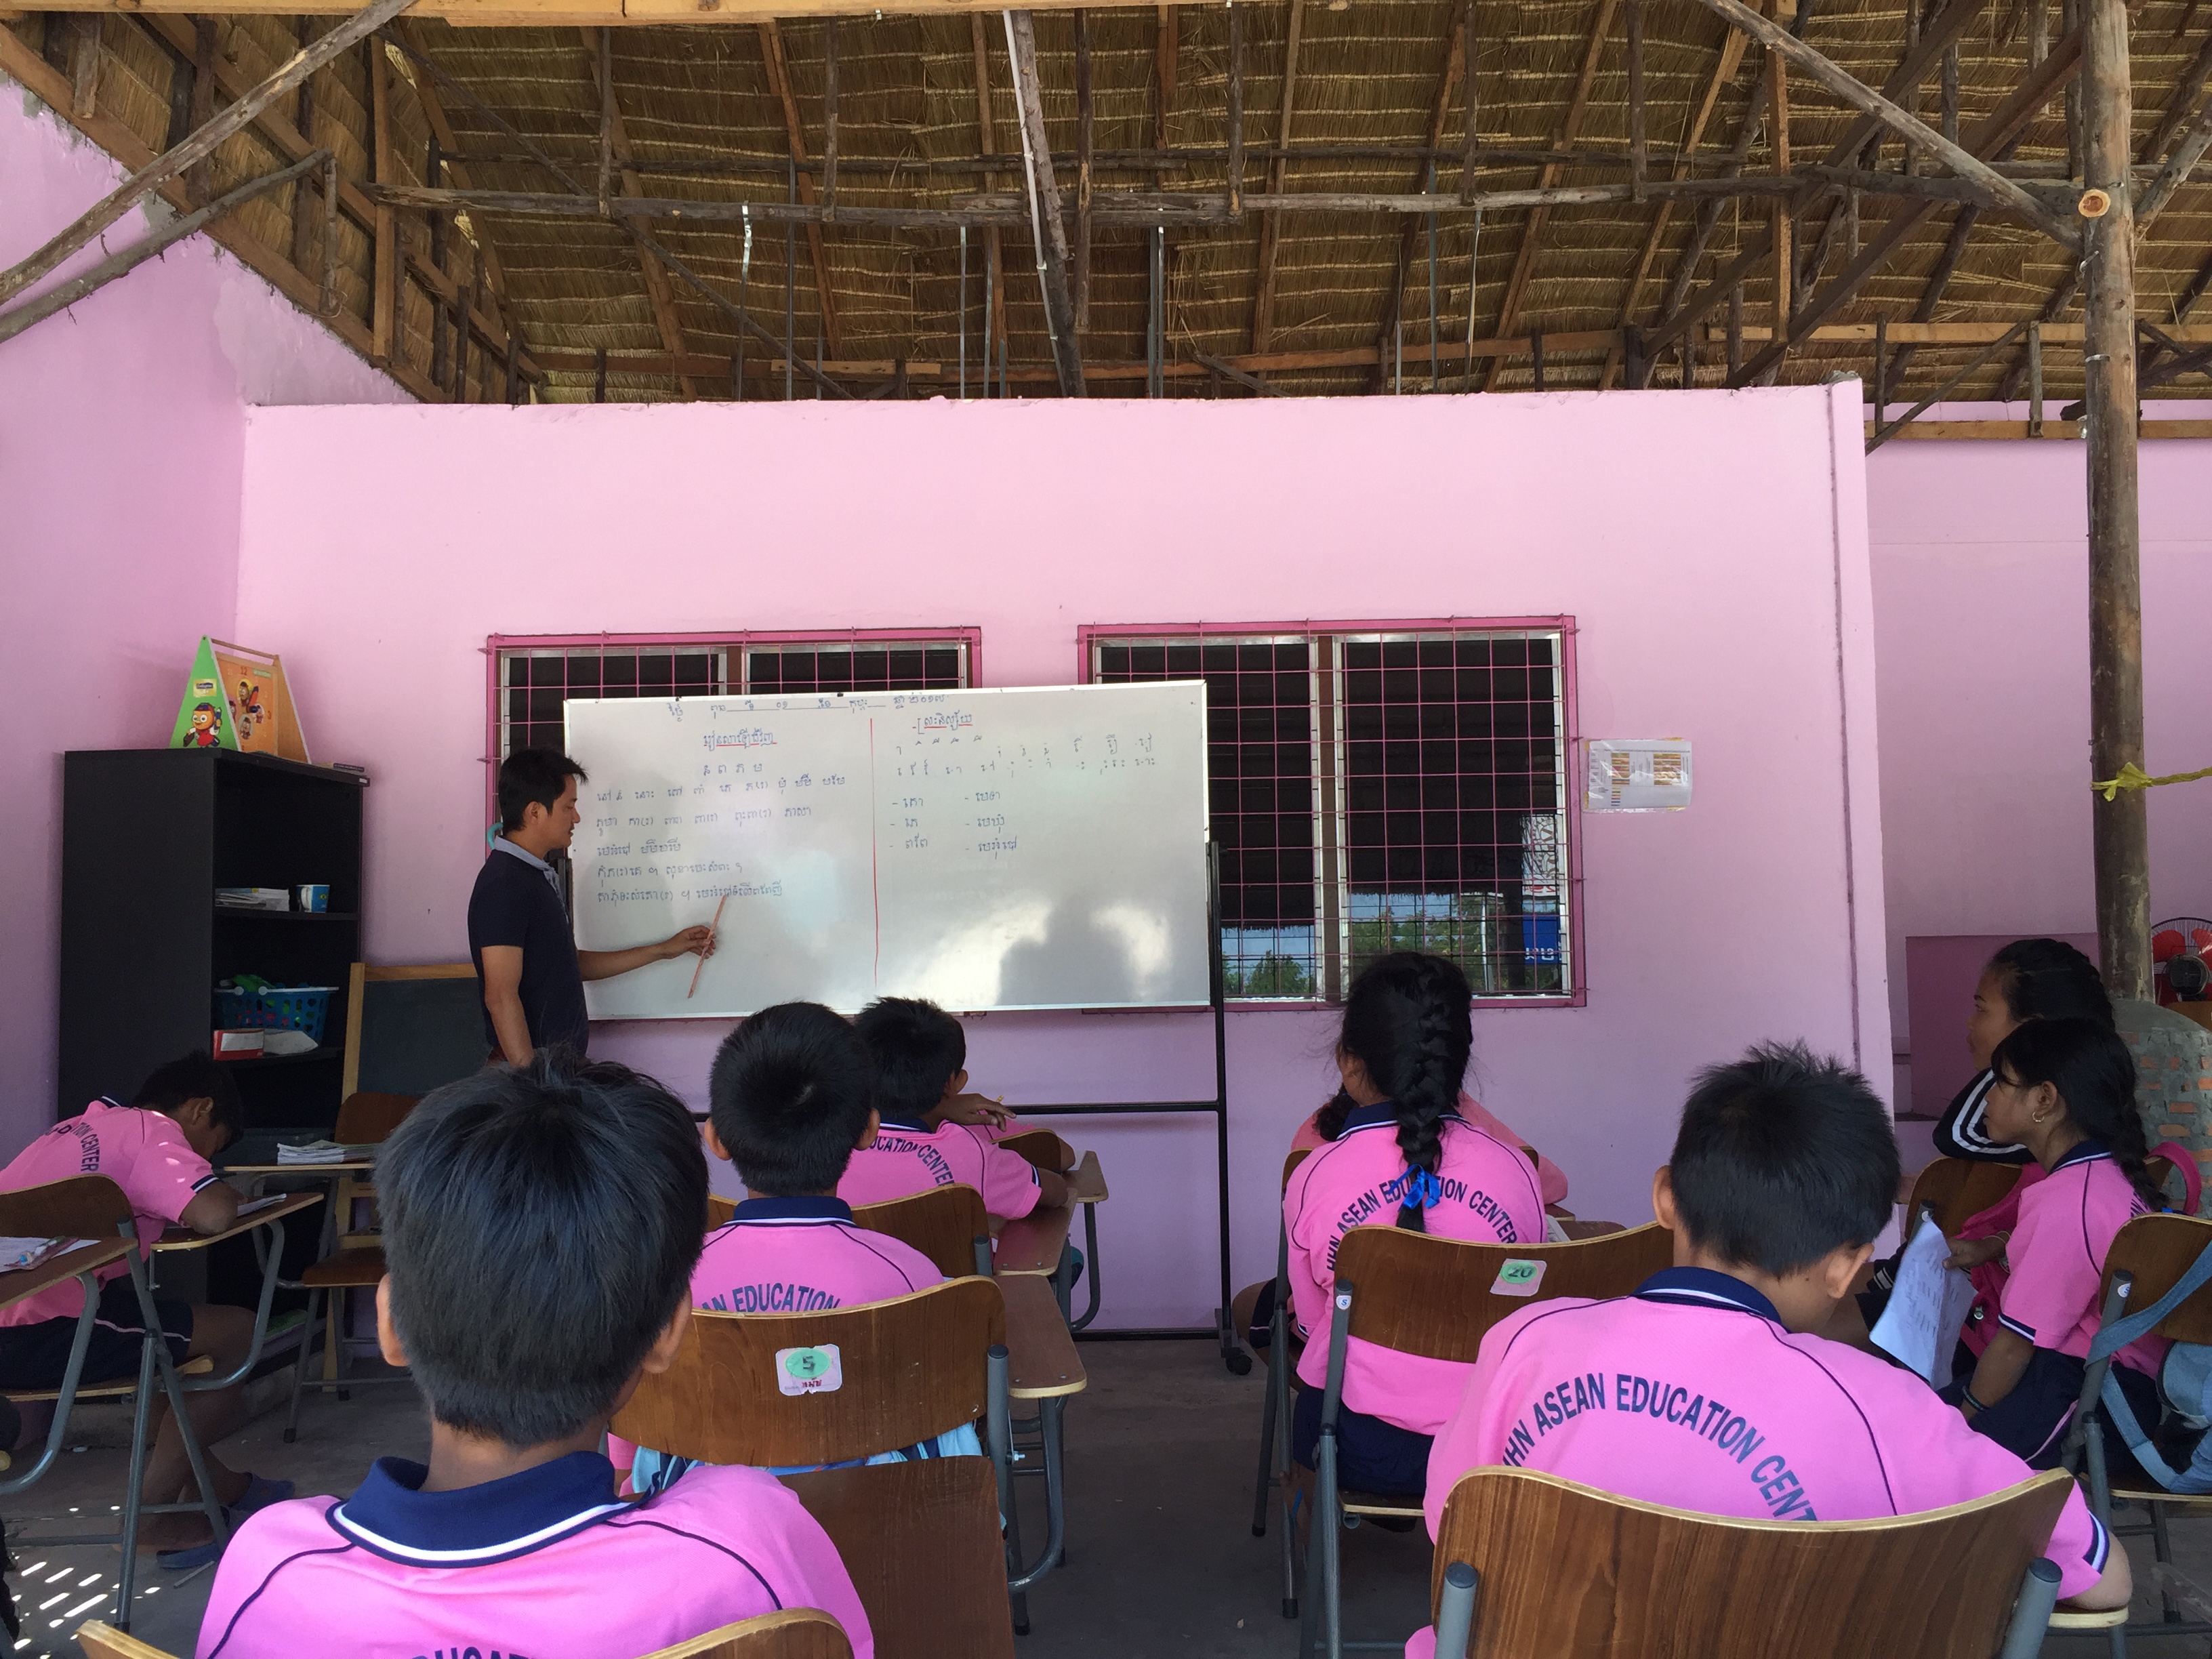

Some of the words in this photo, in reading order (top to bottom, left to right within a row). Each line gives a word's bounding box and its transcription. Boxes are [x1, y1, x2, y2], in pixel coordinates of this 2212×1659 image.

[80, 1134, 100, 1172] CENTER
[1469, 1190, 1518, 1244] CENTER
[1533, 1372, 1606, 1437] ASEAN
[1616, 1374, 1765, 1464] EDUCATION
